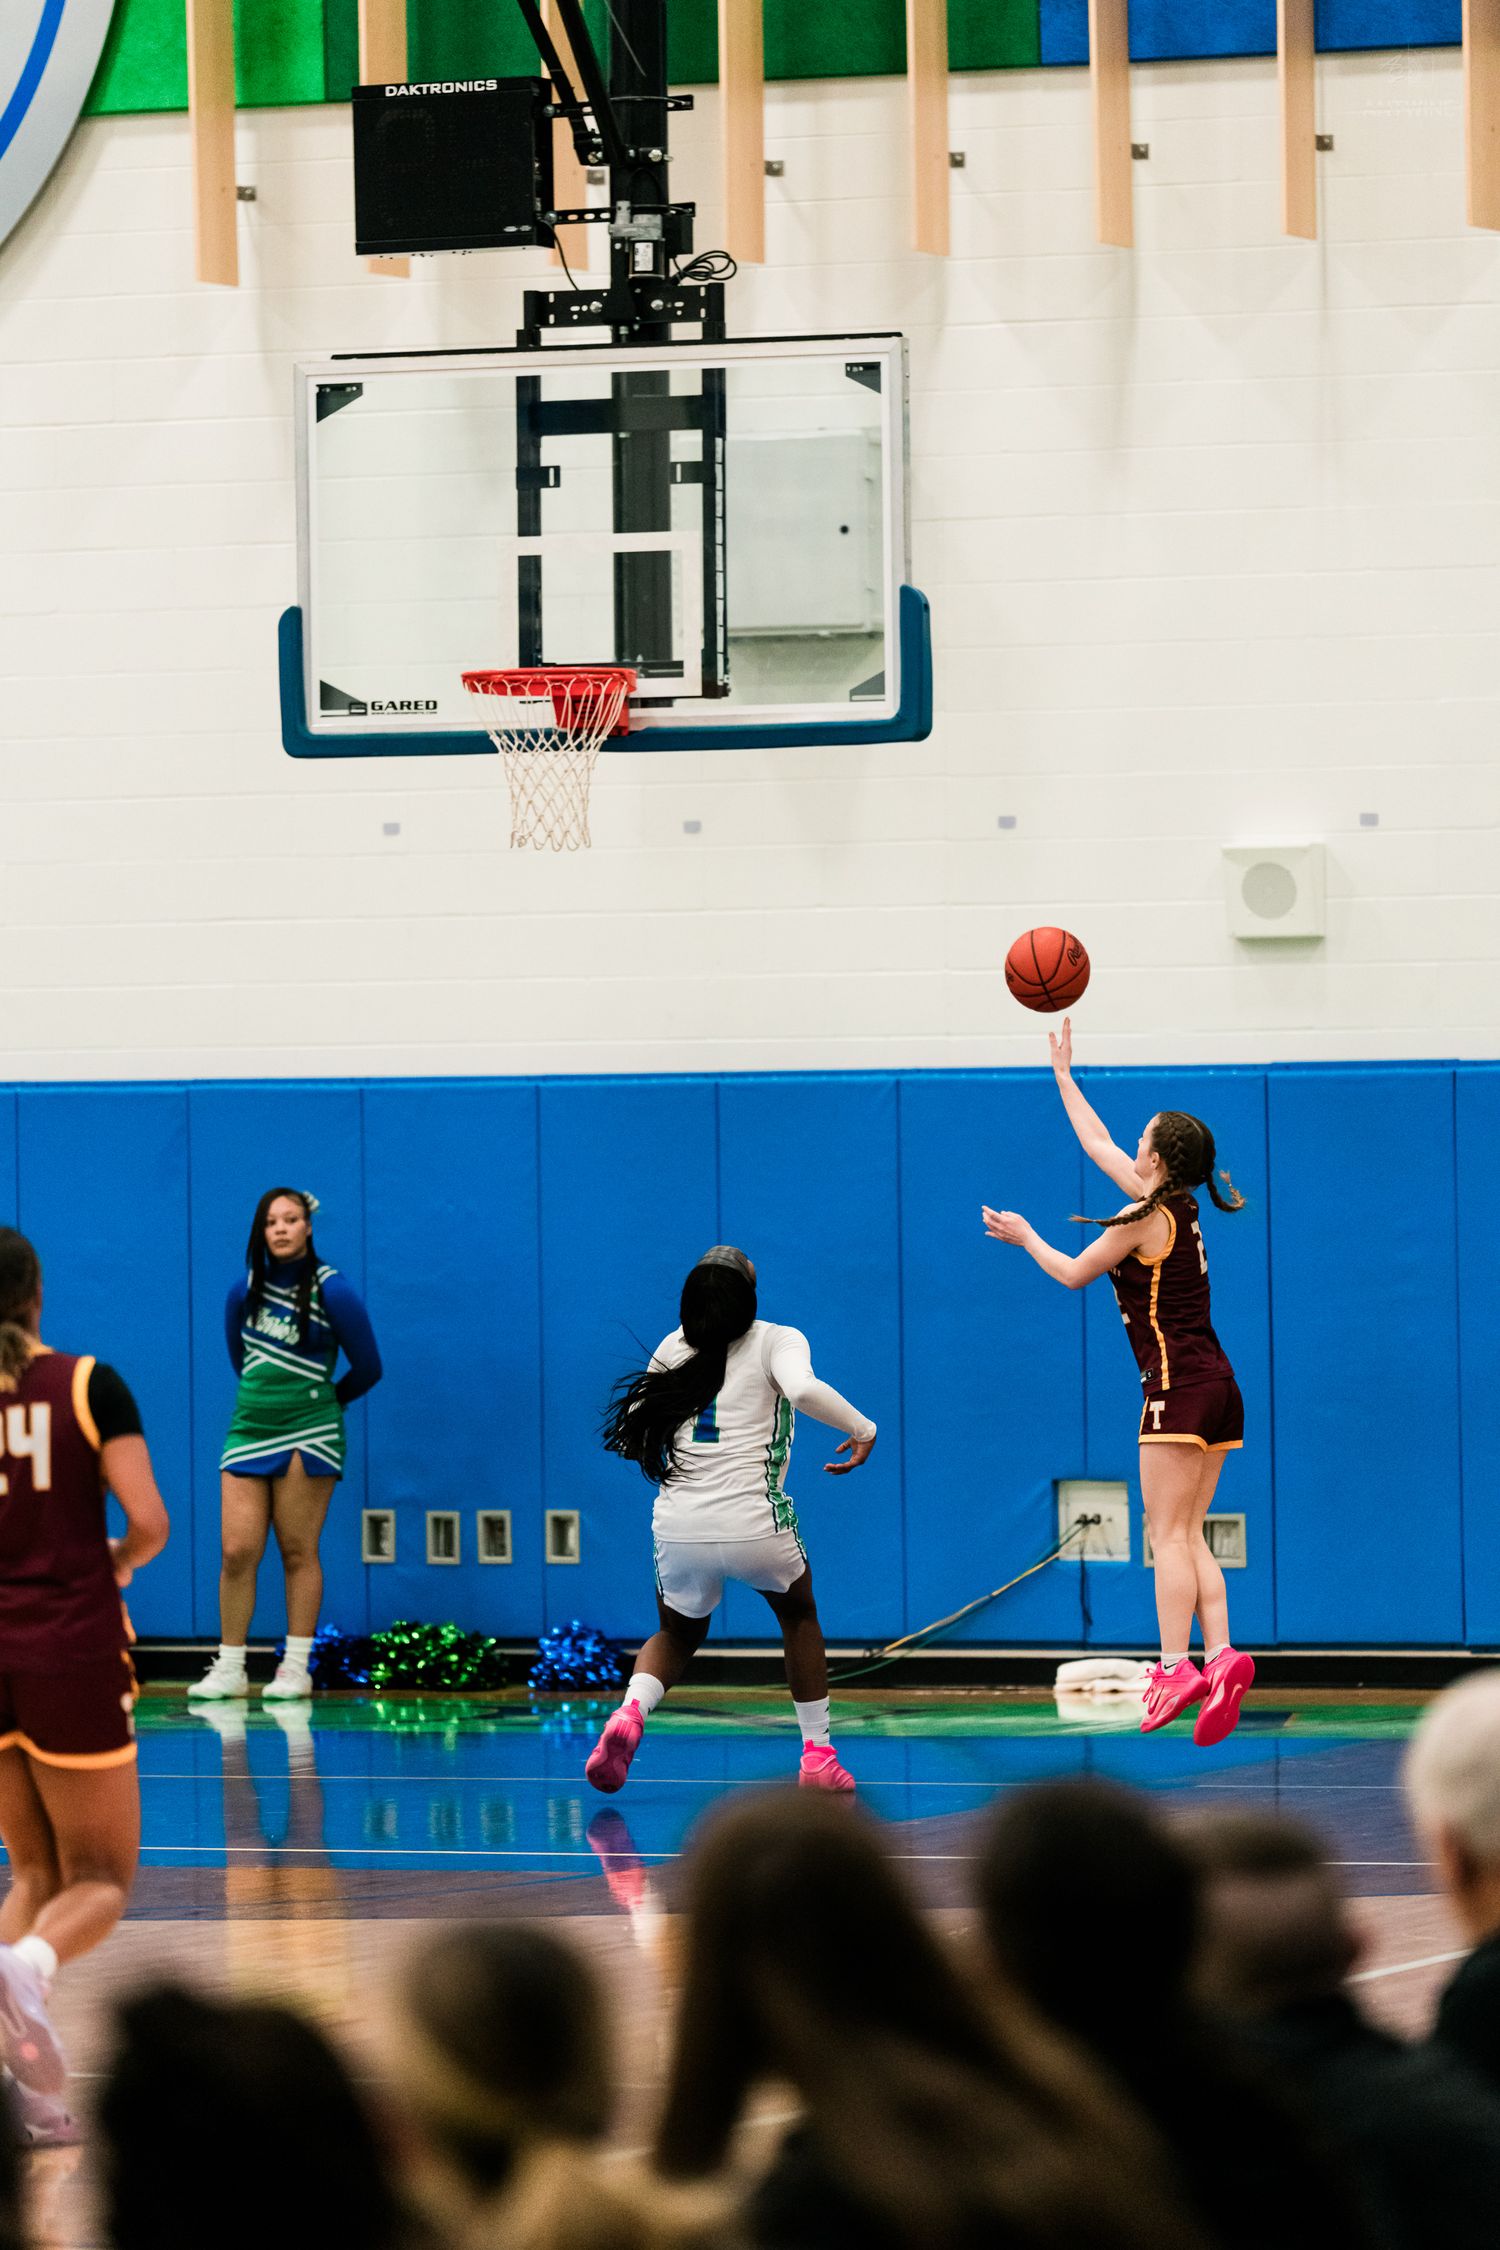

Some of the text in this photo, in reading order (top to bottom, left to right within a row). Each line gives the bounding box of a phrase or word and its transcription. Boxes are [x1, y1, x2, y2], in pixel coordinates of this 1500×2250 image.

[385, 80, 498, 97] DAKTRONICS
[371, 700, 438, 711] GARED
[1149, 1400, 1166, 1430] T
[0, 1402, 52, 1492] 4
